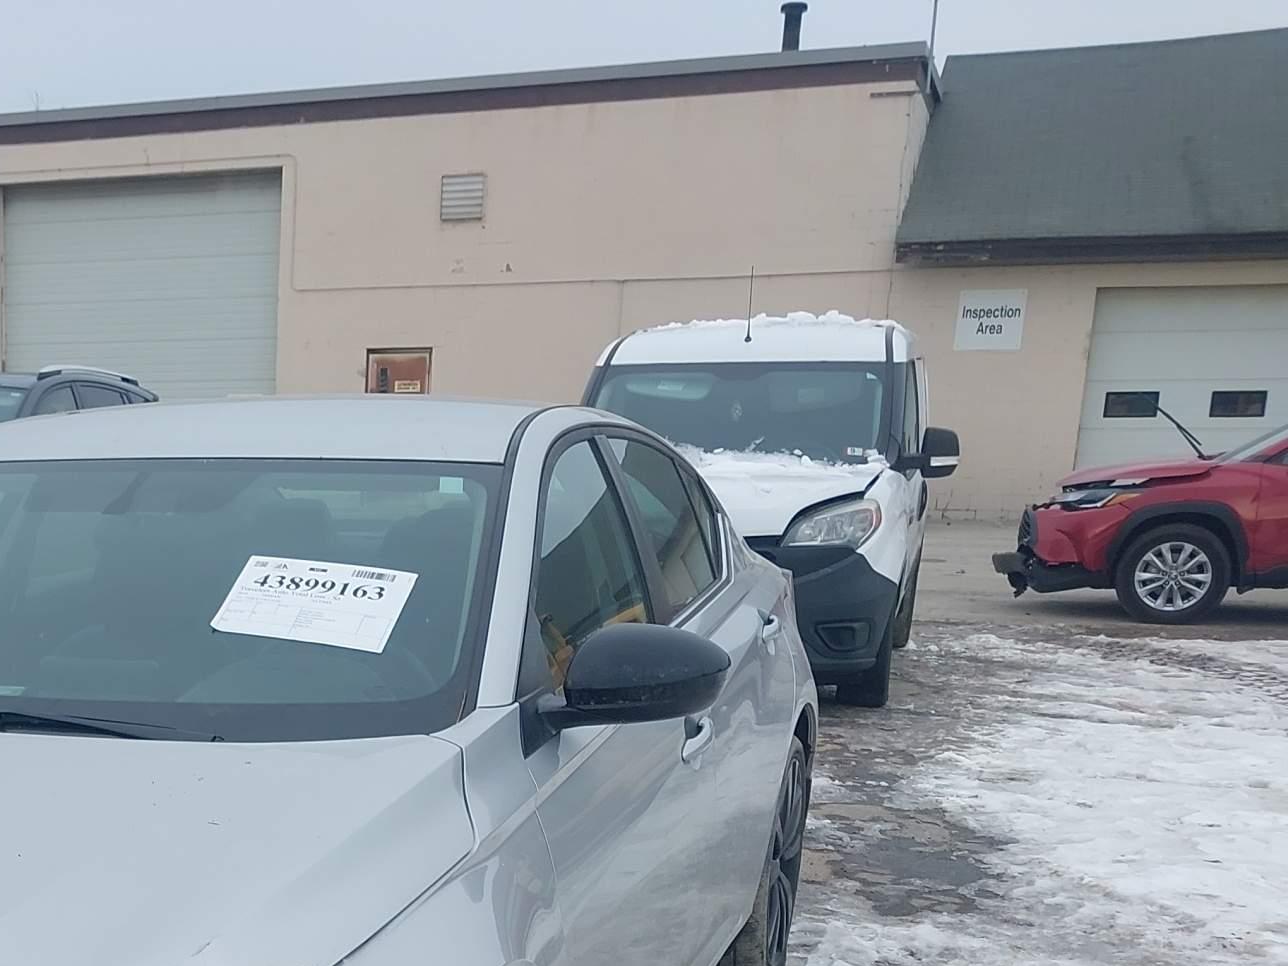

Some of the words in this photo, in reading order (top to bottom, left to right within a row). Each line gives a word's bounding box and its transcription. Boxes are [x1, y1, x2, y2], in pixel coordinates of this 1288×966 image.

[962, 305, 1021, 320] Inspection
[976, 321, 1003, 335] Area
[253, 574, 386, 601] 43899163
